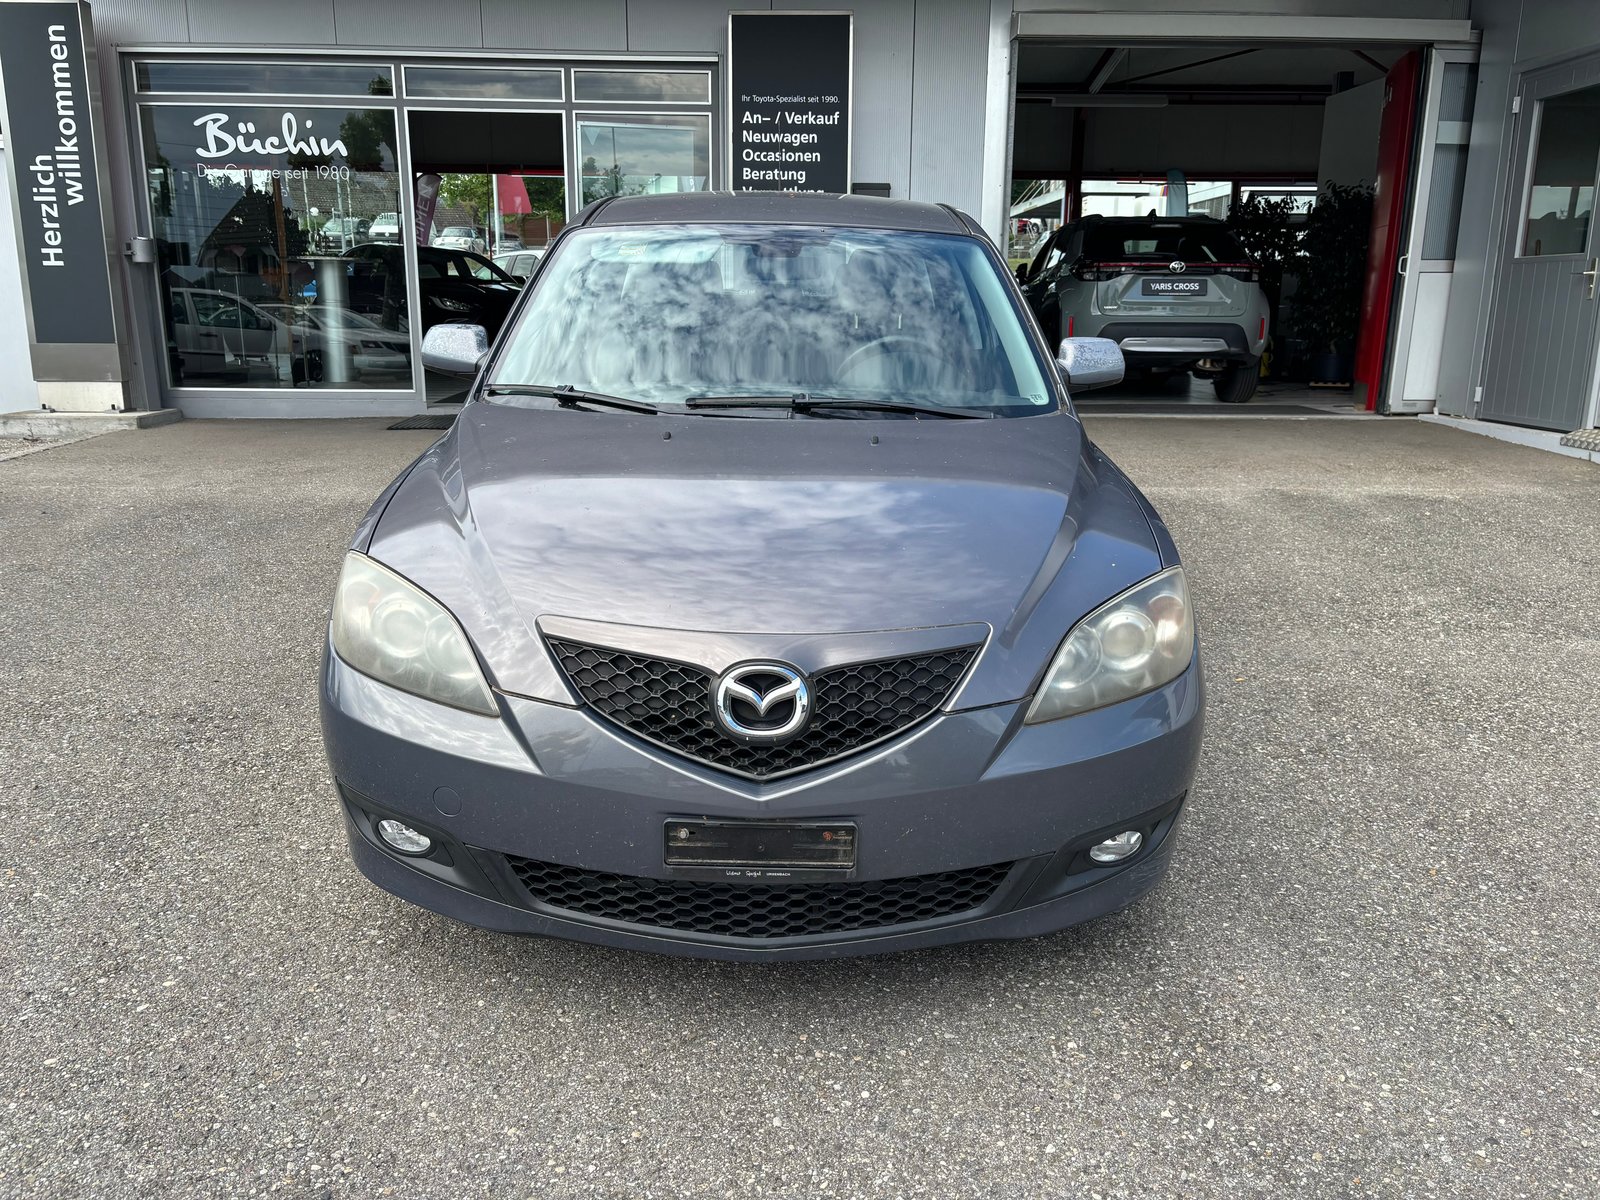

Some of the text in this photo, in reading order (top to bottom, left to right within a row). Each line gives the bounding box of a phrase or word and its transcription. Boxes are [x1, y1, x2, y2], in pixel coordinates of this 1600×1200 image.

[741, 94, 840, 104] Ihr Toyota-Spezialist seit 1990.
[48, 24, 84, 206] willkommen
[784, 110, 840, 125] Verkauf
[193, 112, 348, 158] Büchin
[742, 130, 818, 146] Neuwagen
[742, 149, 821, 162] Occasionen
[286, 165, 309, 179] seit
[314, 165, 350, 180] 1980
[742, 167, 806, 184] Beratung
[29, 154, 65, 267] Herzlich
[1150, 282, 1200, 291] YARIS CROSS
